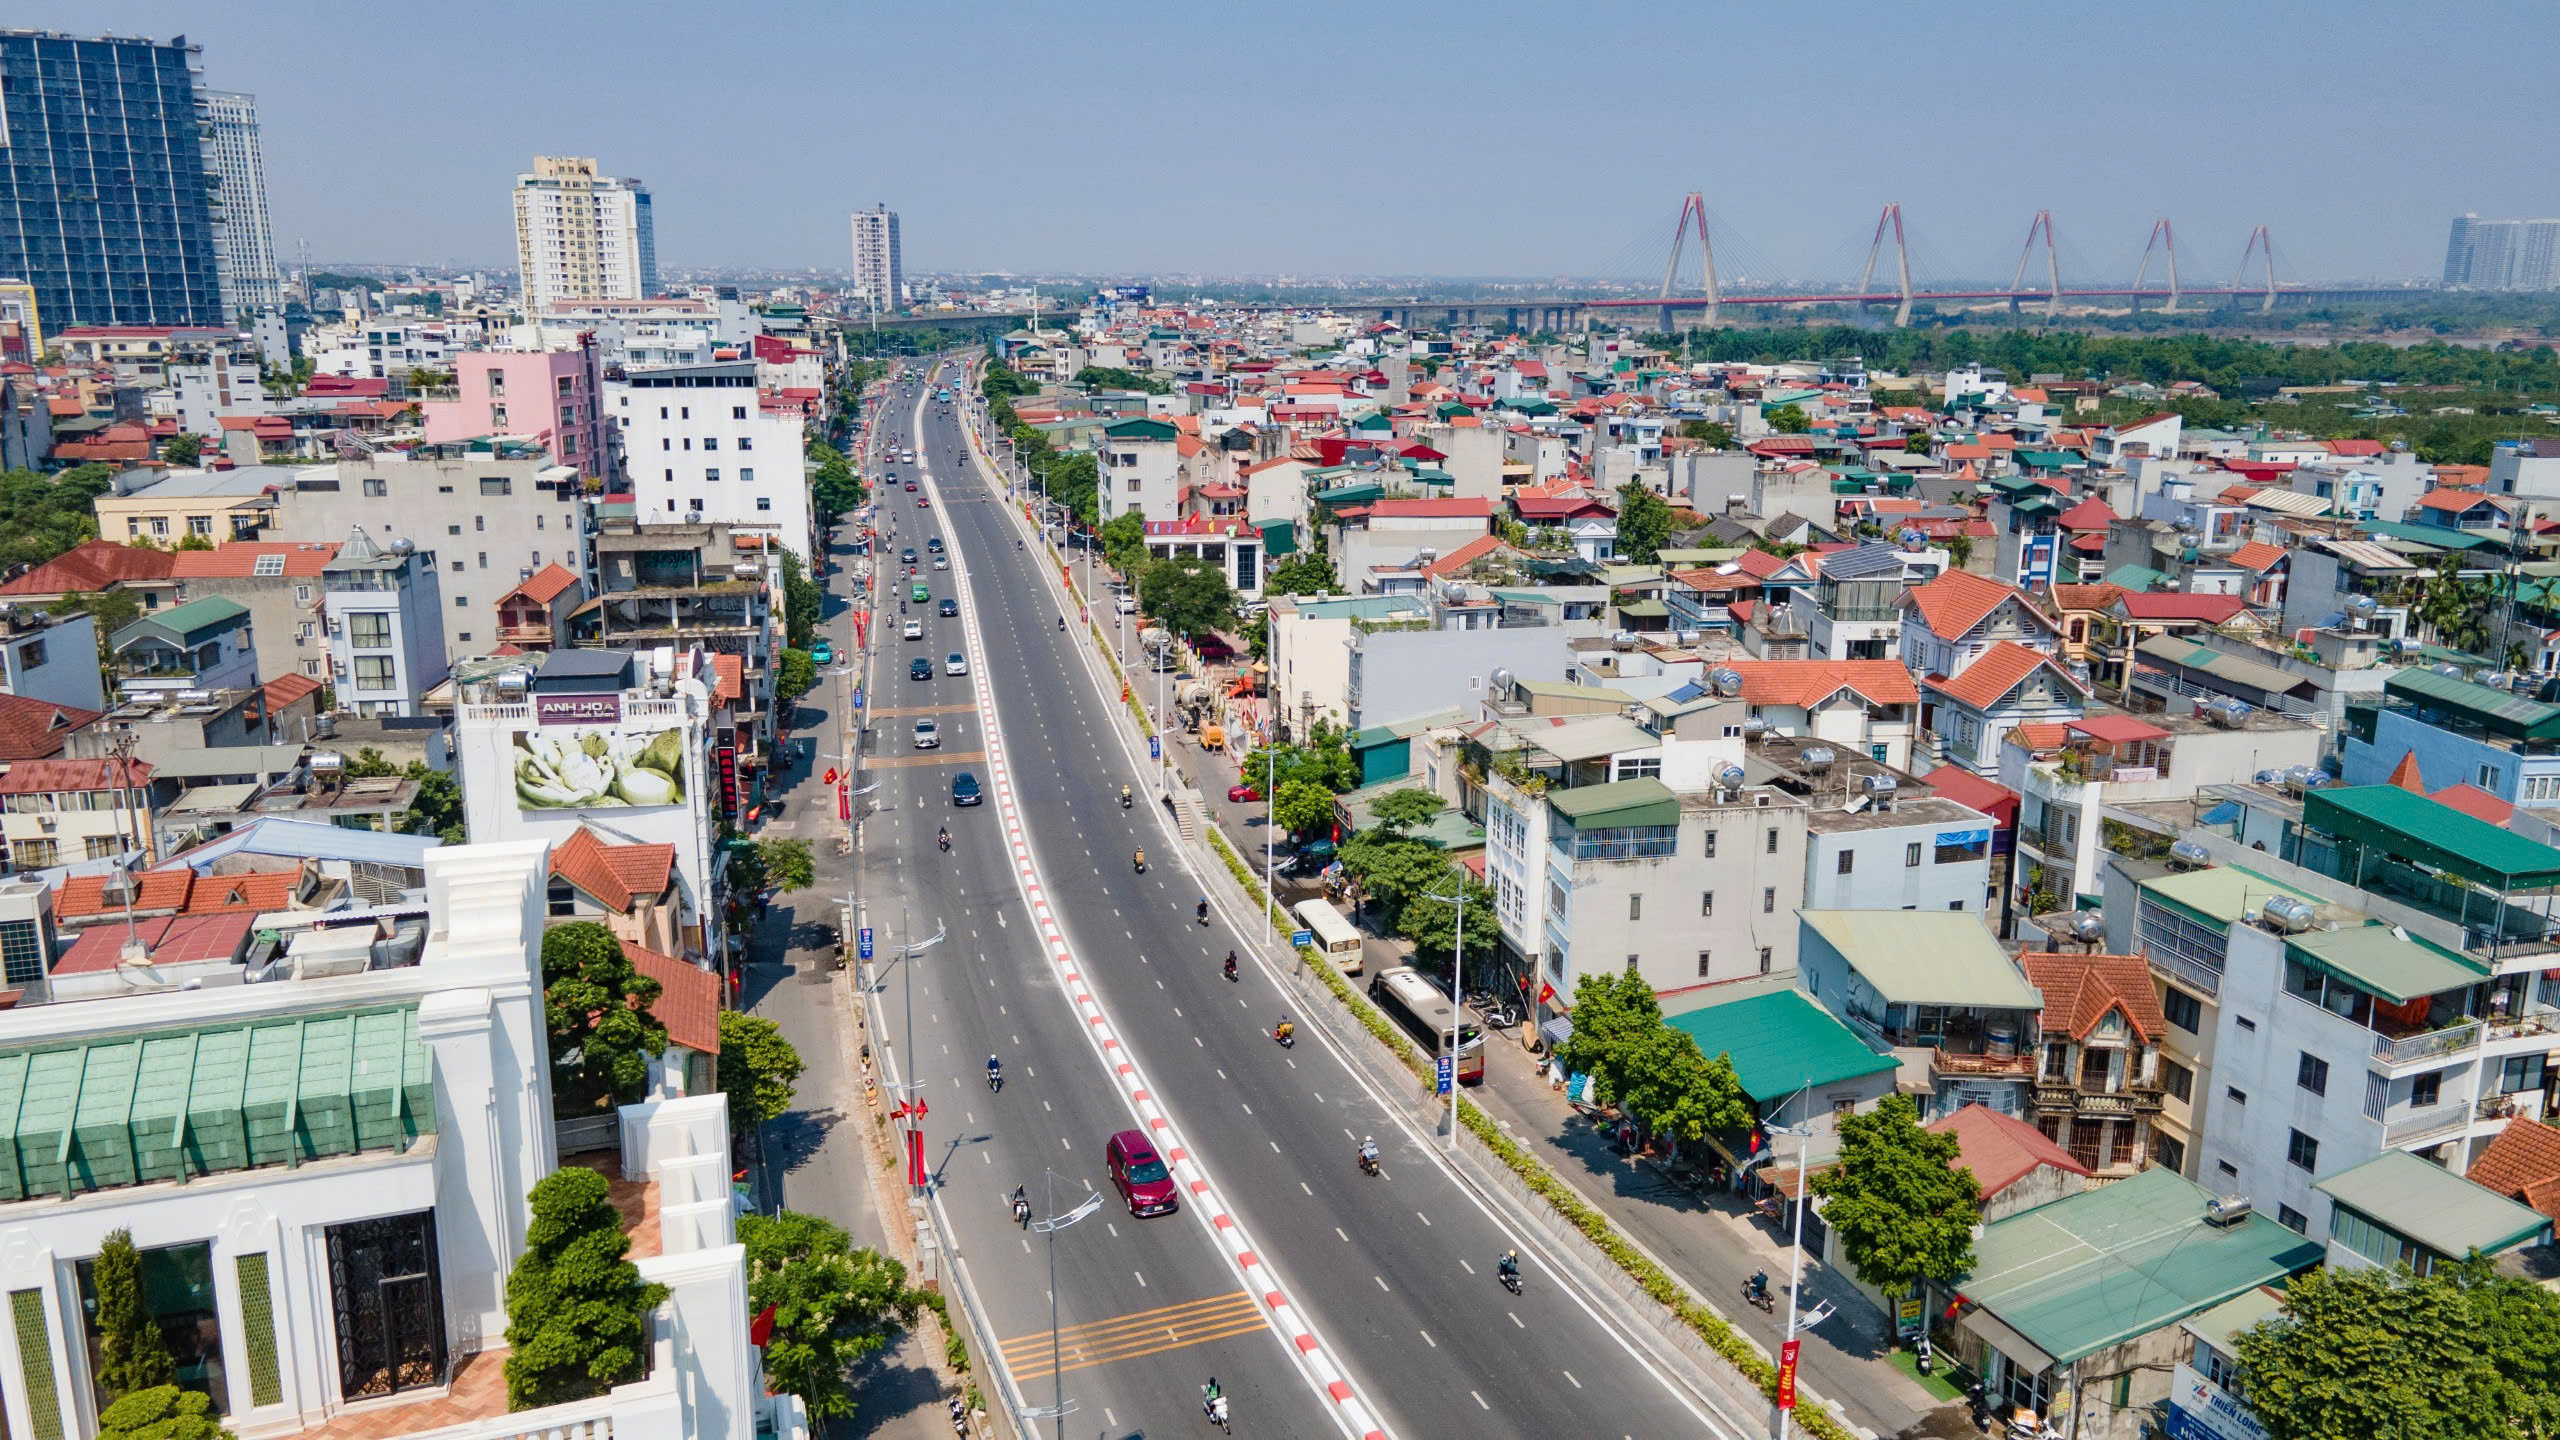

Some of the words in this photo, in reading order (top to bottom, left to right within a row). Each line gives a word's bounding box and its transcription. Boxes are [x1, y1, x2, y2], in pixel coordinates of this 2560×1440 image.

[542, 702, 576, 712] ANH
[580, 702, 615, 711] HOA
[2237, 1413, 2263, 1436] LONG
